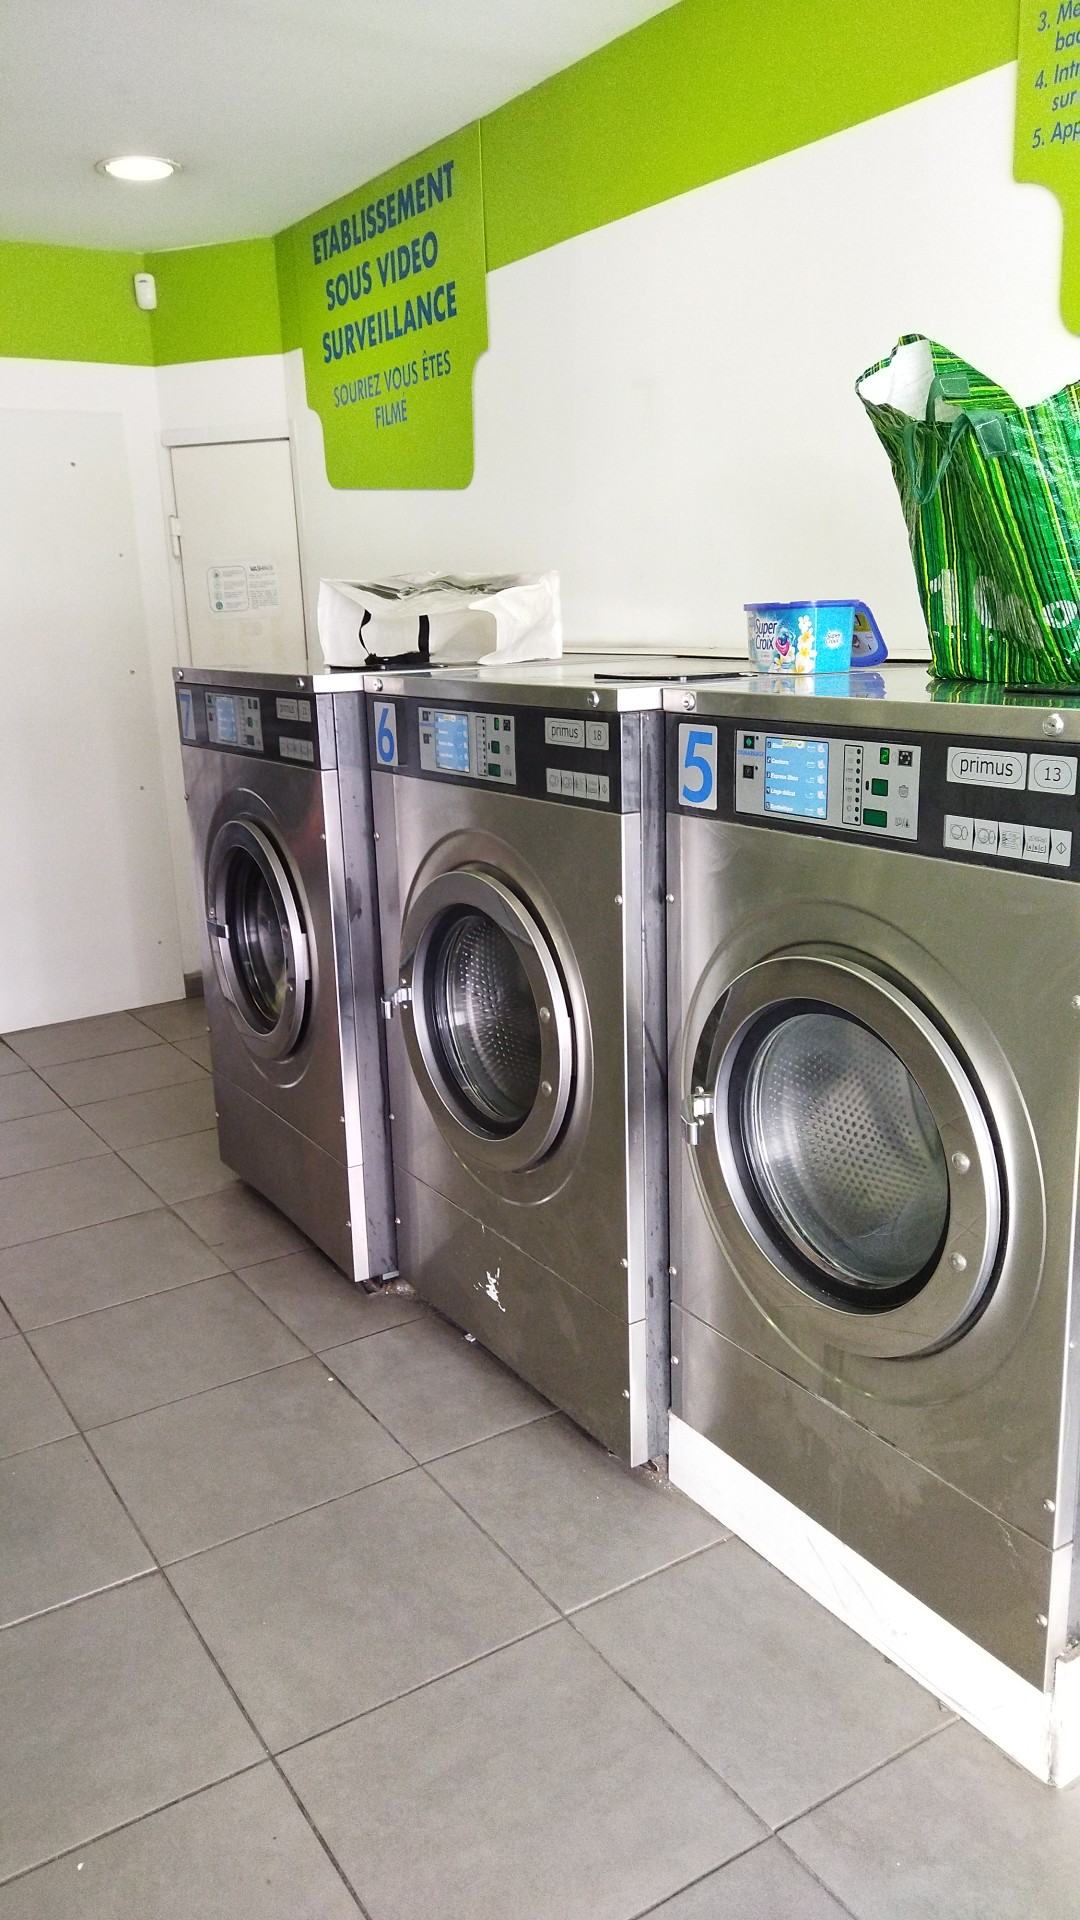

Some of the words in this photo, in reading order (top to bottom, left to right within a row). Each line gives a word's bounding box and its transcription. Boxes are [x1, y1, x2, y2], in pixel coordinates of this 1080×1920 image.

[1037, 10, 1050, 32] 3.
[1034, 69, 1048, 90] 4.
[1051, 90, 1077, 111] sur
[1031, 128, 1045, 149] 5.
[312, 160, 455, 266] ETABLISSEMENT
[325, 261, 372, 311] SOUS
[376, 231, 439, 288] VIDEO
[322, 281, 458, 364] SURVEILLANCE
[333, 373, 382, 408] SOURIEZ
[384, 361, 419, 393] VOUS
[422, 350, 452, 382] ÊTES
[375, 391, 408, 429] FILMÉ
[755, 618, 778, 637] Super
[756, 634, 775, 650] Croix
[180, 693, 191, 737] 7
[377, 707, 395, 763] 6
[551, 725, 579, 740] primus
[593, 729, 602, 741] 18
[881, 749, 889, 762] 2
[682, 730, 713, 803] 5
[960, 756, 1013, 777] primus
[1044, 767, 1062, 782] 13
